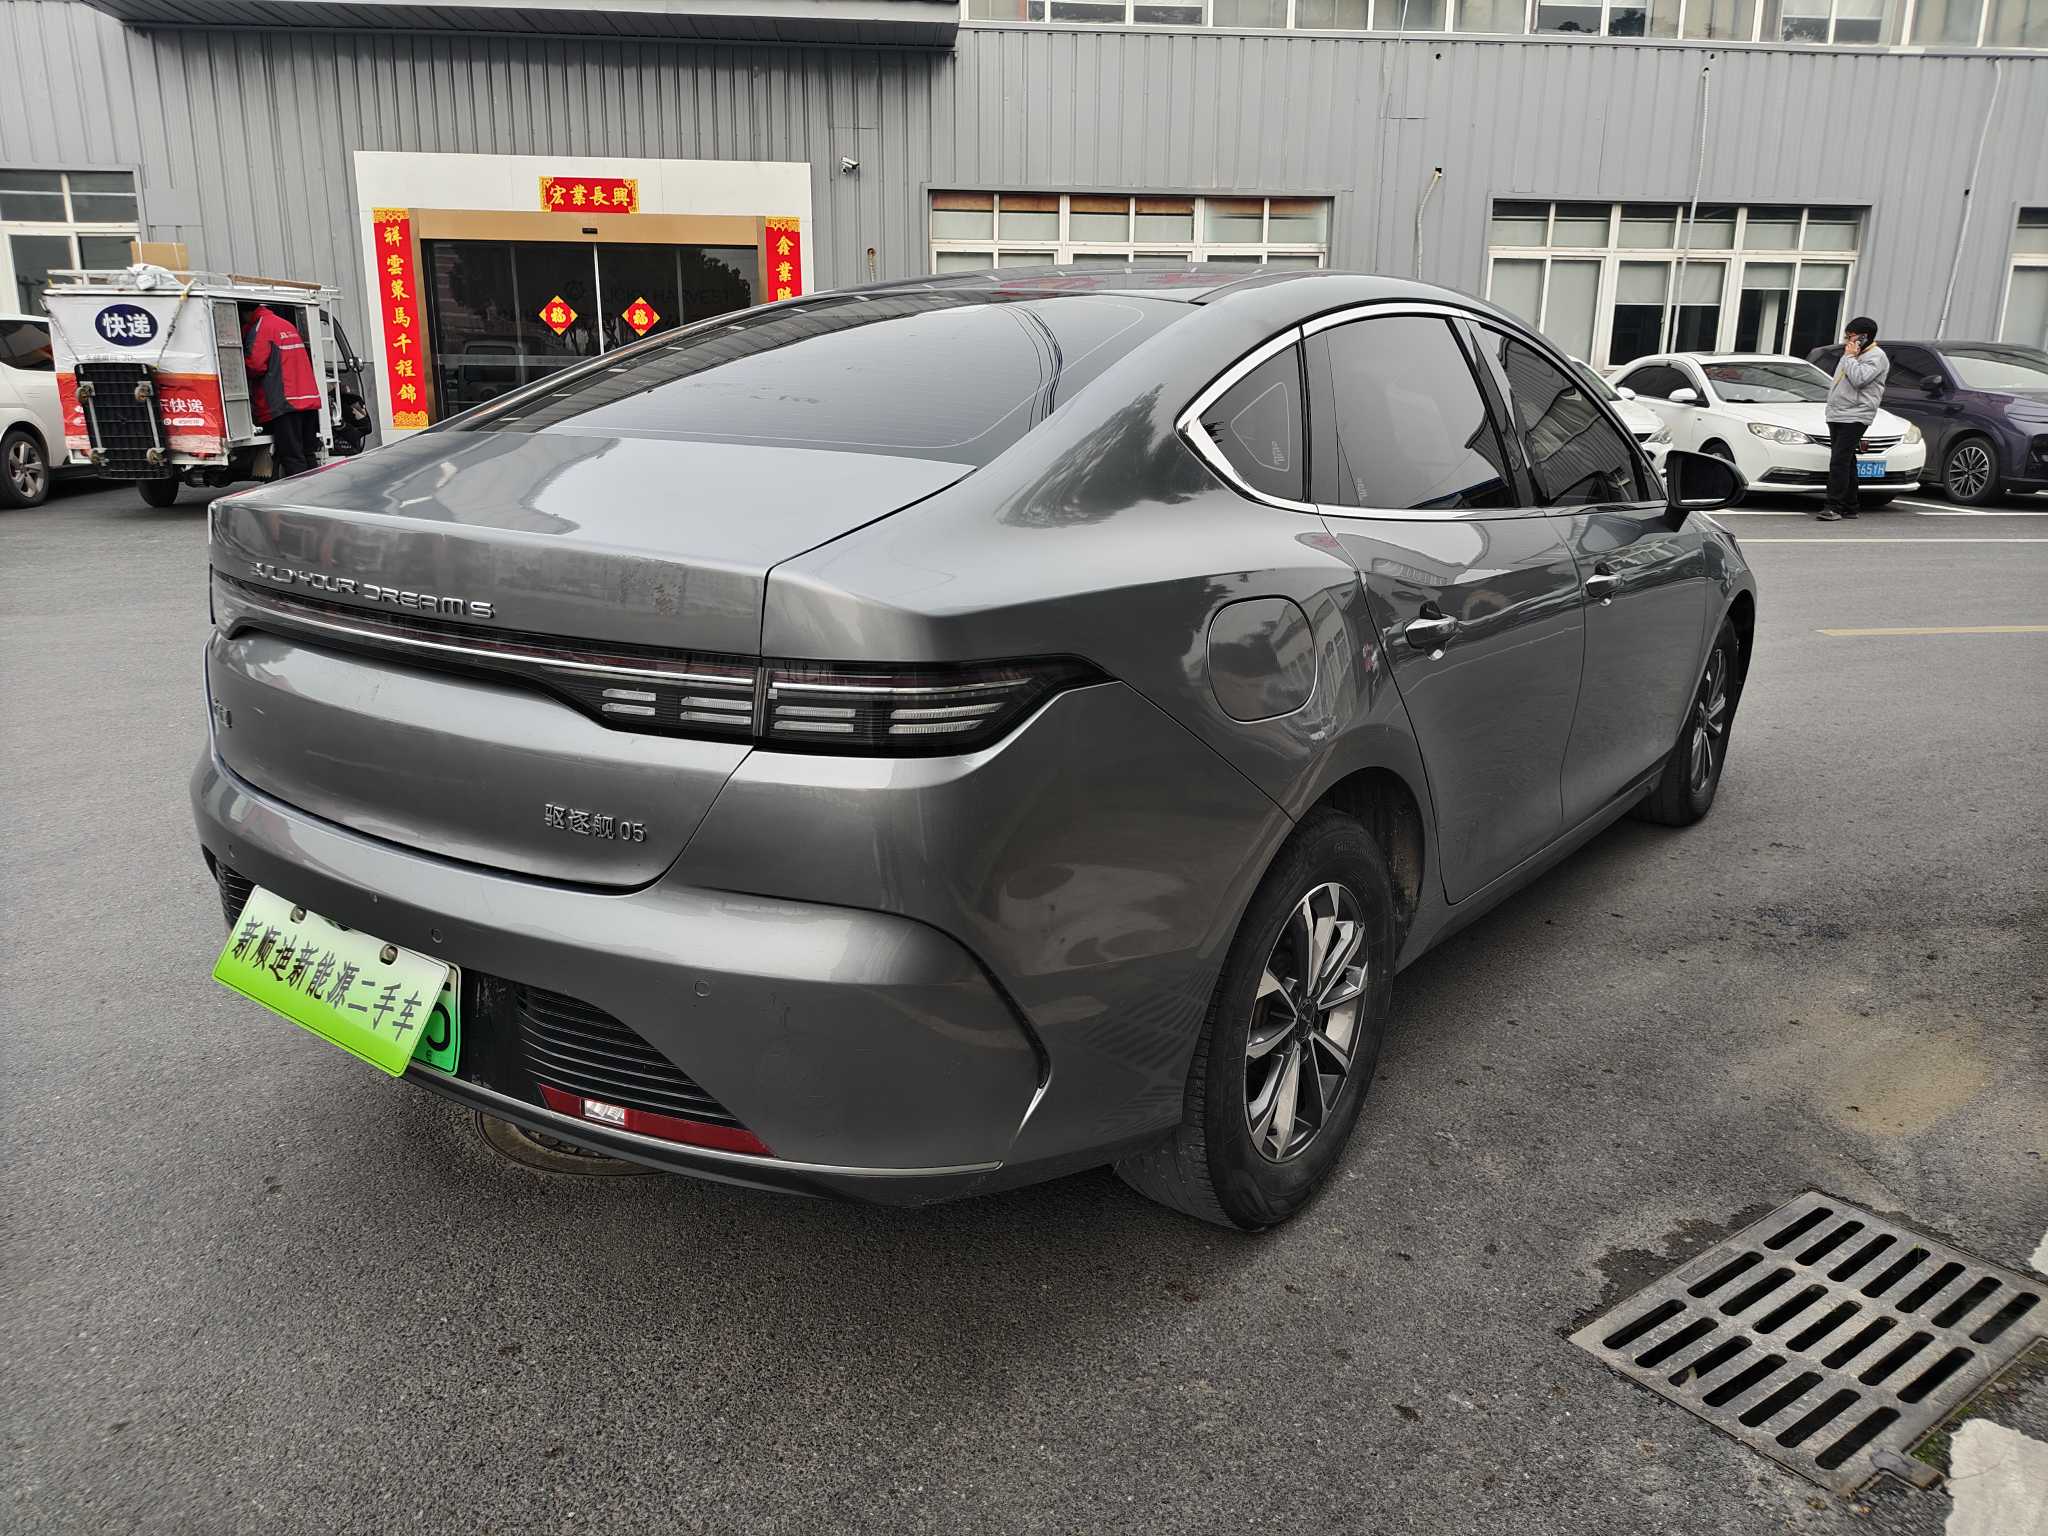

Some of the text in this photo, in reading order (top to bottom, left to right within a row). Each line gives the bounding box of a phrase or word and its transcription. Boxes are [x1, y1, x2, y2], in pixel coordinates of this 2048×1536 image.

[102, 312, 152, 338] 快递
[363, 582, 497, 619] DREAMS
[619, 820, 647, 843] 05
